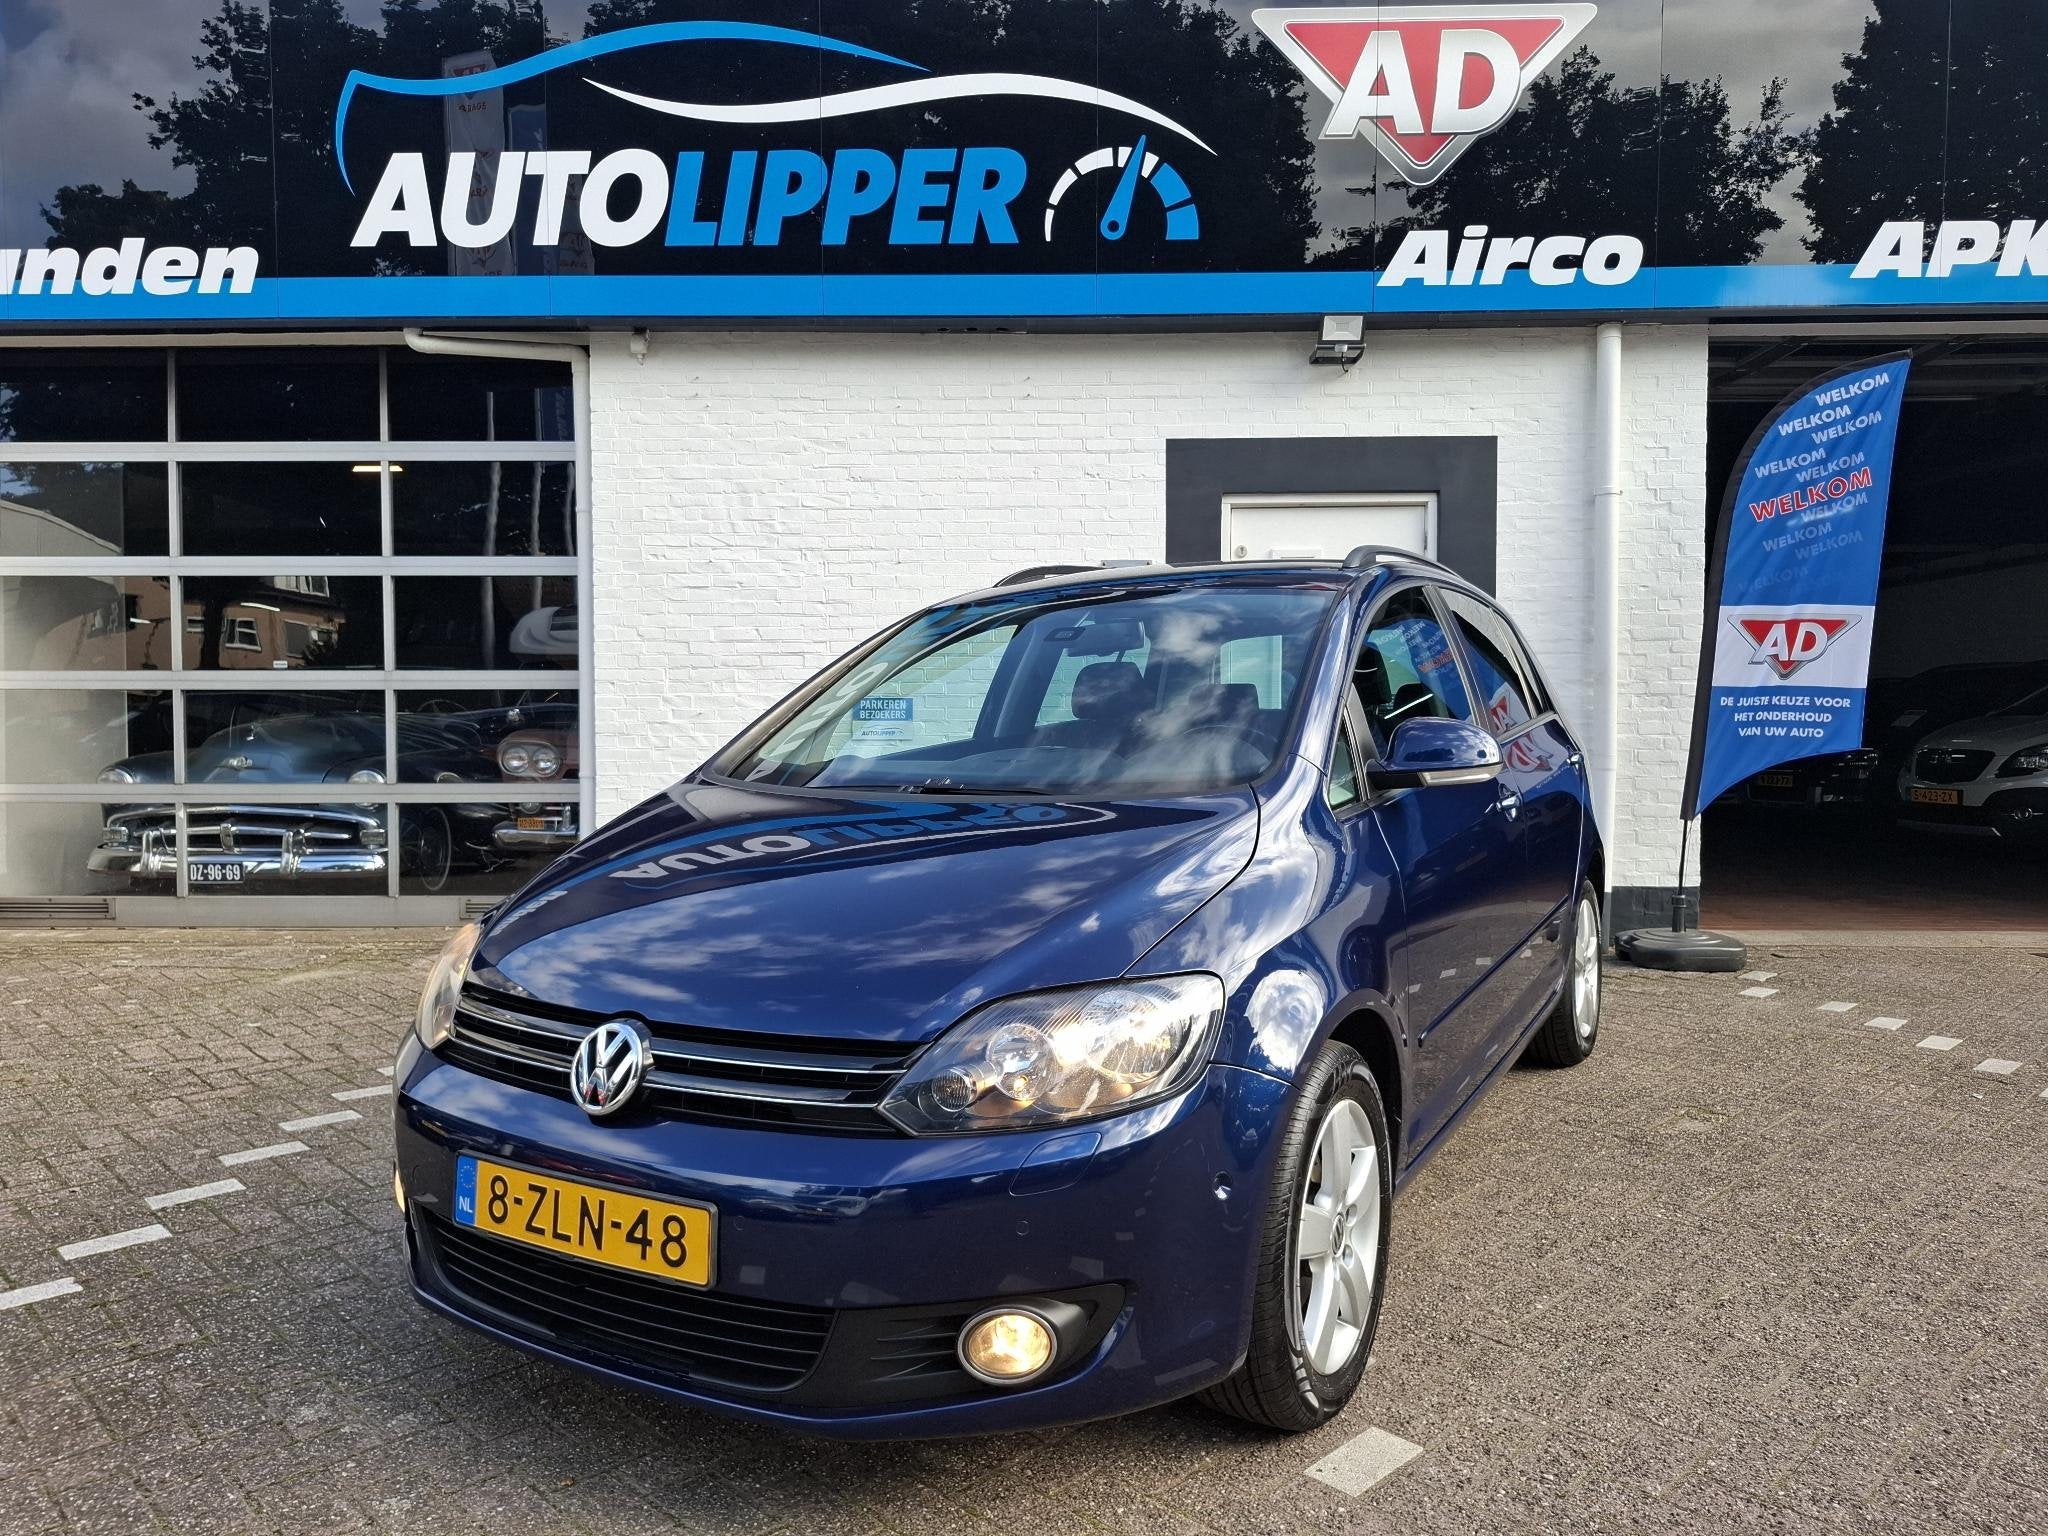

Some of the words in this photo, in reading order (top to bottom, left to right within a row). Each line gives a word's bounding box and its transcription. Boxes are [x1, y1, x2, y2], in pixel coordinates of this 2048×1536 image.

[1318, 28, 1523, 139] AD
[350, 147, 1027, 248] AUTOLIPPER
[1376, 224, 1644, 288] Airco
[1850, 219, 2048, 279] APK
[1815, 372, 1890, 407] WELKOM
[1778, 404, 1852, 436] WELKOM
[1811, 410, 1882, 444] WELKOM
[1754, 447, 1826, 479] WELKOM
[1796, 451, 1865, 483] WELKOM
[1749, 466, 1873, 522] WELKOM
[1800, 492, 1868, 523] WELKOM
[1762, 522, 1832, 552] WELKOM
[1749, 621, 1829, 664] AD
[860, 700, 906, 710] PARKEREN
[860, 710, 906, 719] BEZOEKERS
[1720, 696, 1734, 707] DE
[1736, 696, 1769, 707] JUISTE
[1771, 695, 1811, 706] KEUZE
[1814, 697, 1851, 708] VOOR
[1734, 712, 1754, 722] HET
[1755, 711, 1832, 723] ONDERHOUD
[1738, 726, 1761, 737] VAN
[1764, 726, 1787, 737] UW
[1789, 727, 1824, 738] AUTO
[190, 863, 241, 881] DZ-96-69
[458, 1195, 474, 1214] NL
[487, 1174, 688, 1269] 8-ZLN-48
